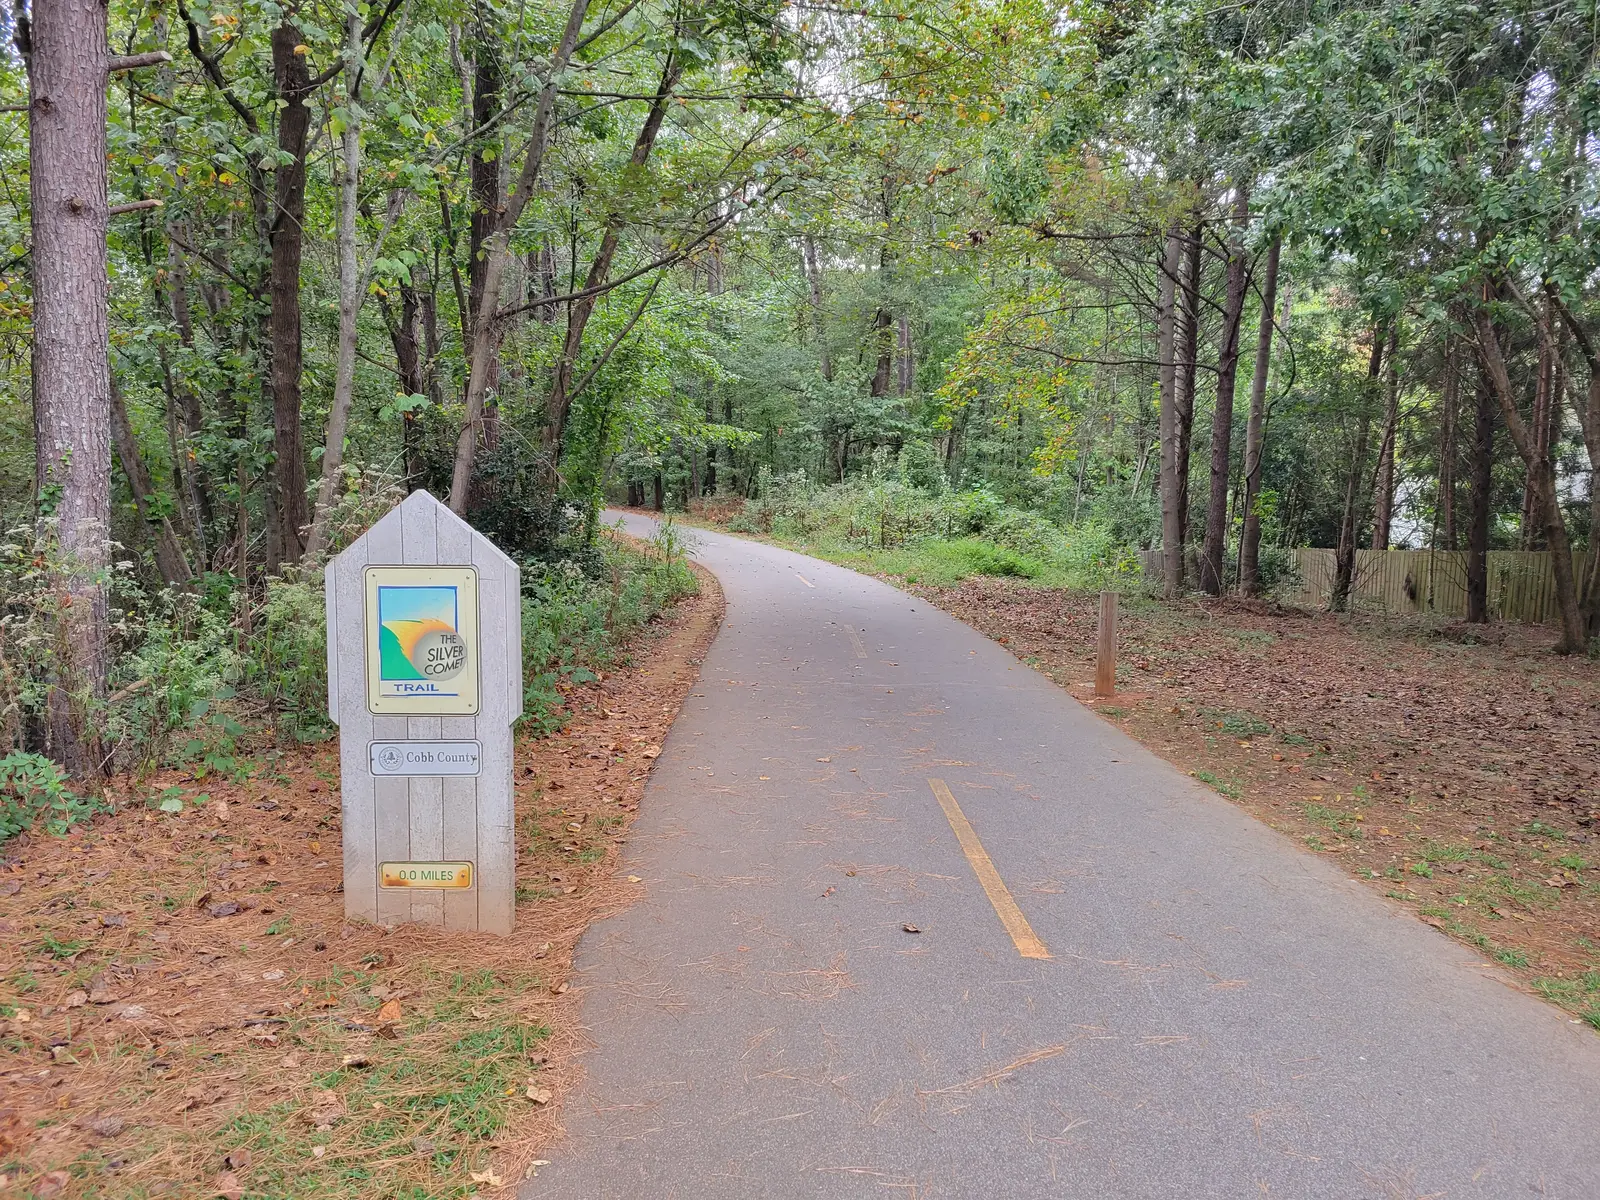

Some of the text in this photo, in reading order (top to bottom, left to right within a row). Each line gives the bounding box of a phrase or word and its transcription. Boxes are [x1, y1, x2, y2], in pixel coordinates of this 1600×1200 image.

[440, 634, 457, 645] THE
[427, 645, 464, 662] SILVER
[424, 657, 465, 675] COMET
[393, 683, 440, 692] TRAIL
[406, 751, 477, 766] Cobb County
[399, 869, 454, 881] 0.0 MILES
